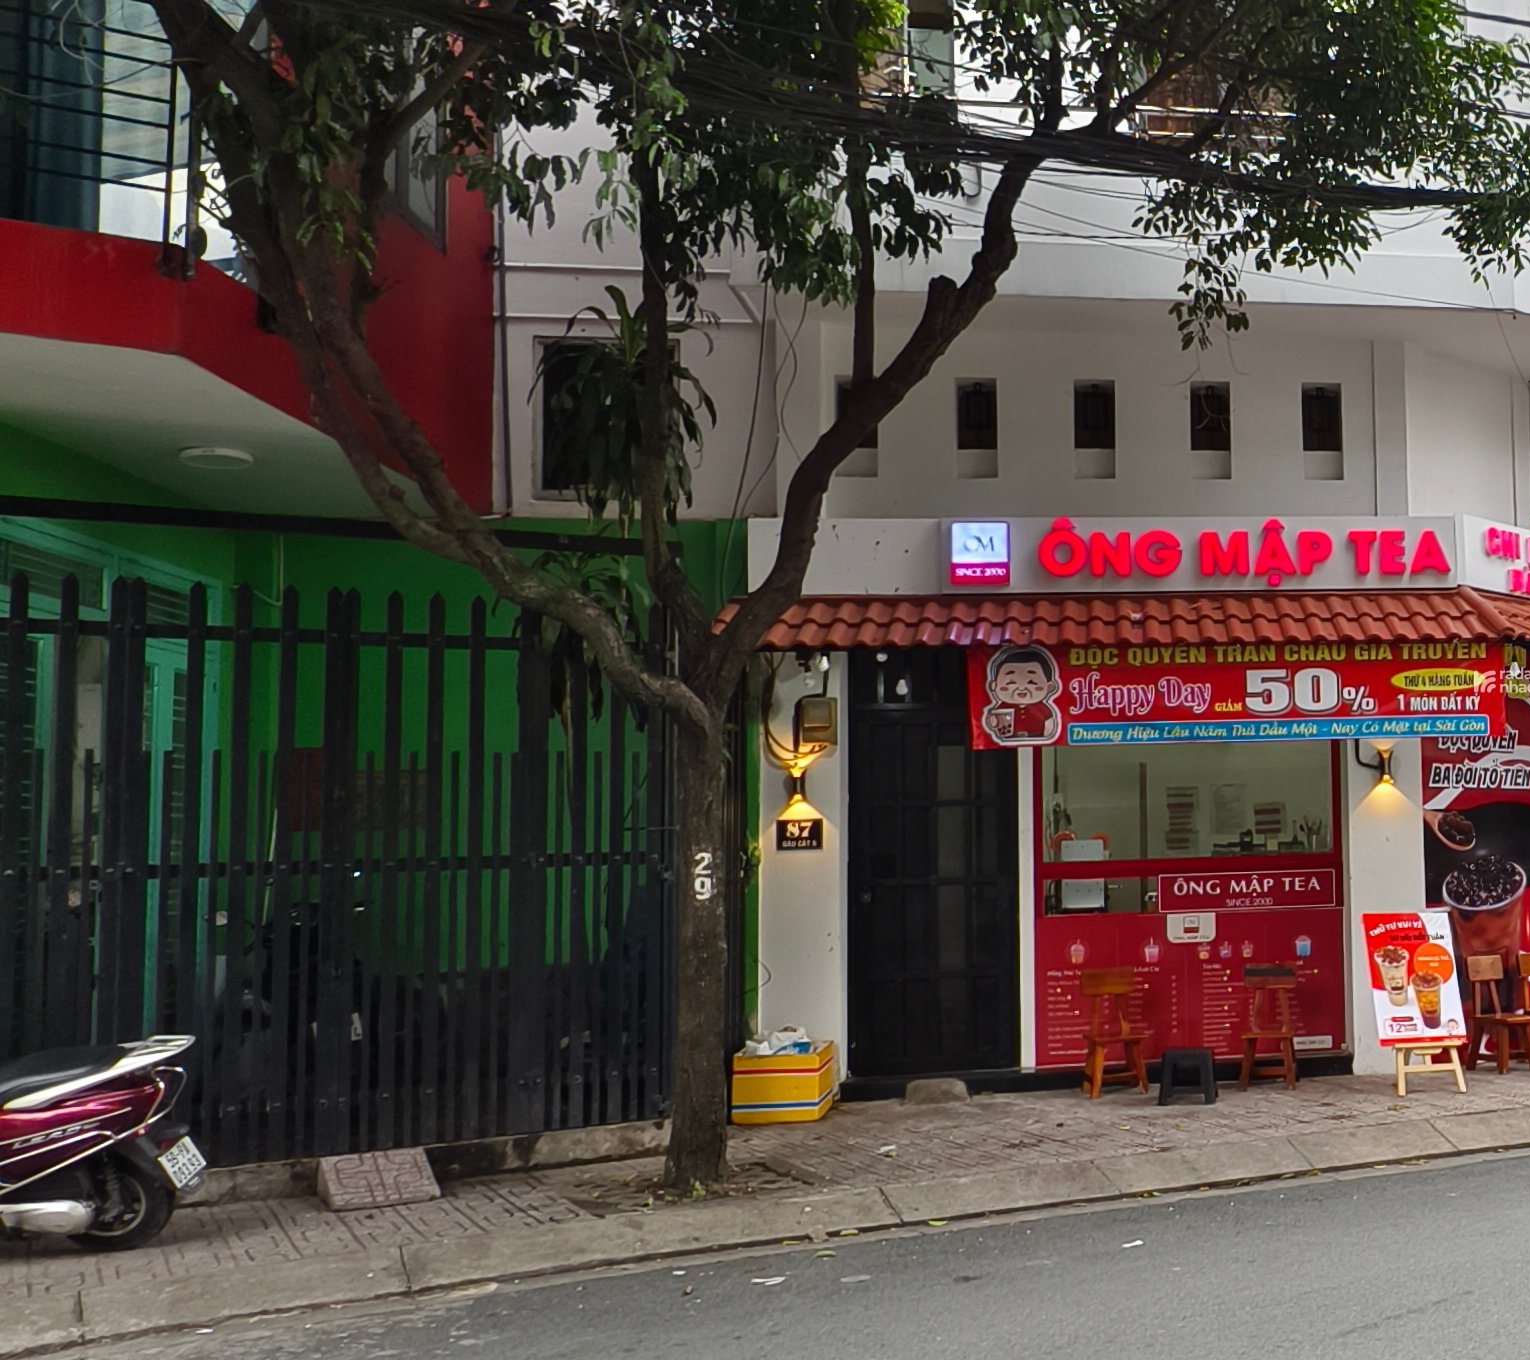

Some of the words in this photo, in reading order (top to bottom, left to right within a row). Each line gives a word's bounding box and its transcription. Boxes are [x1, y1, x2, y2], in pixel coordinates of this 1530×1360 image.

[1039, 516, 1182, 577] ÔNG
[1199, 518, 1333, 587] MẬP
[1346, 530, 1451, 576] TEA
[1485, 527, 1520, 559] CHI
[955, 567, 982, 576] SINCE
[1354, 643, 1392, 661] GIA
[1428, 673, 1452, 687] HÀNG
[1070, 672, 1154, 716] Happy
[1158, 676, 1211, 714] Day
[1397, 694, 1404, 711] 1
[1127, 725, 1160, 740] Hiệu
[1164, 726, 1190, 738] Lâu
[1194, 725, 1228, 737] Năm
[1331, 721, 1359, 735] Nay
[1459, 719, 1486, 731] Gòn
[1432, 765, 1450, 785] BA
[786, 821, 813, 838] 87
[1173, 877, 1221, 896] ÔNG
[1229, 874, 1275, 897] MẬP
[1282, 876, 1321, 892] TEA
[1226, 898, 1251, 907] SINCE
